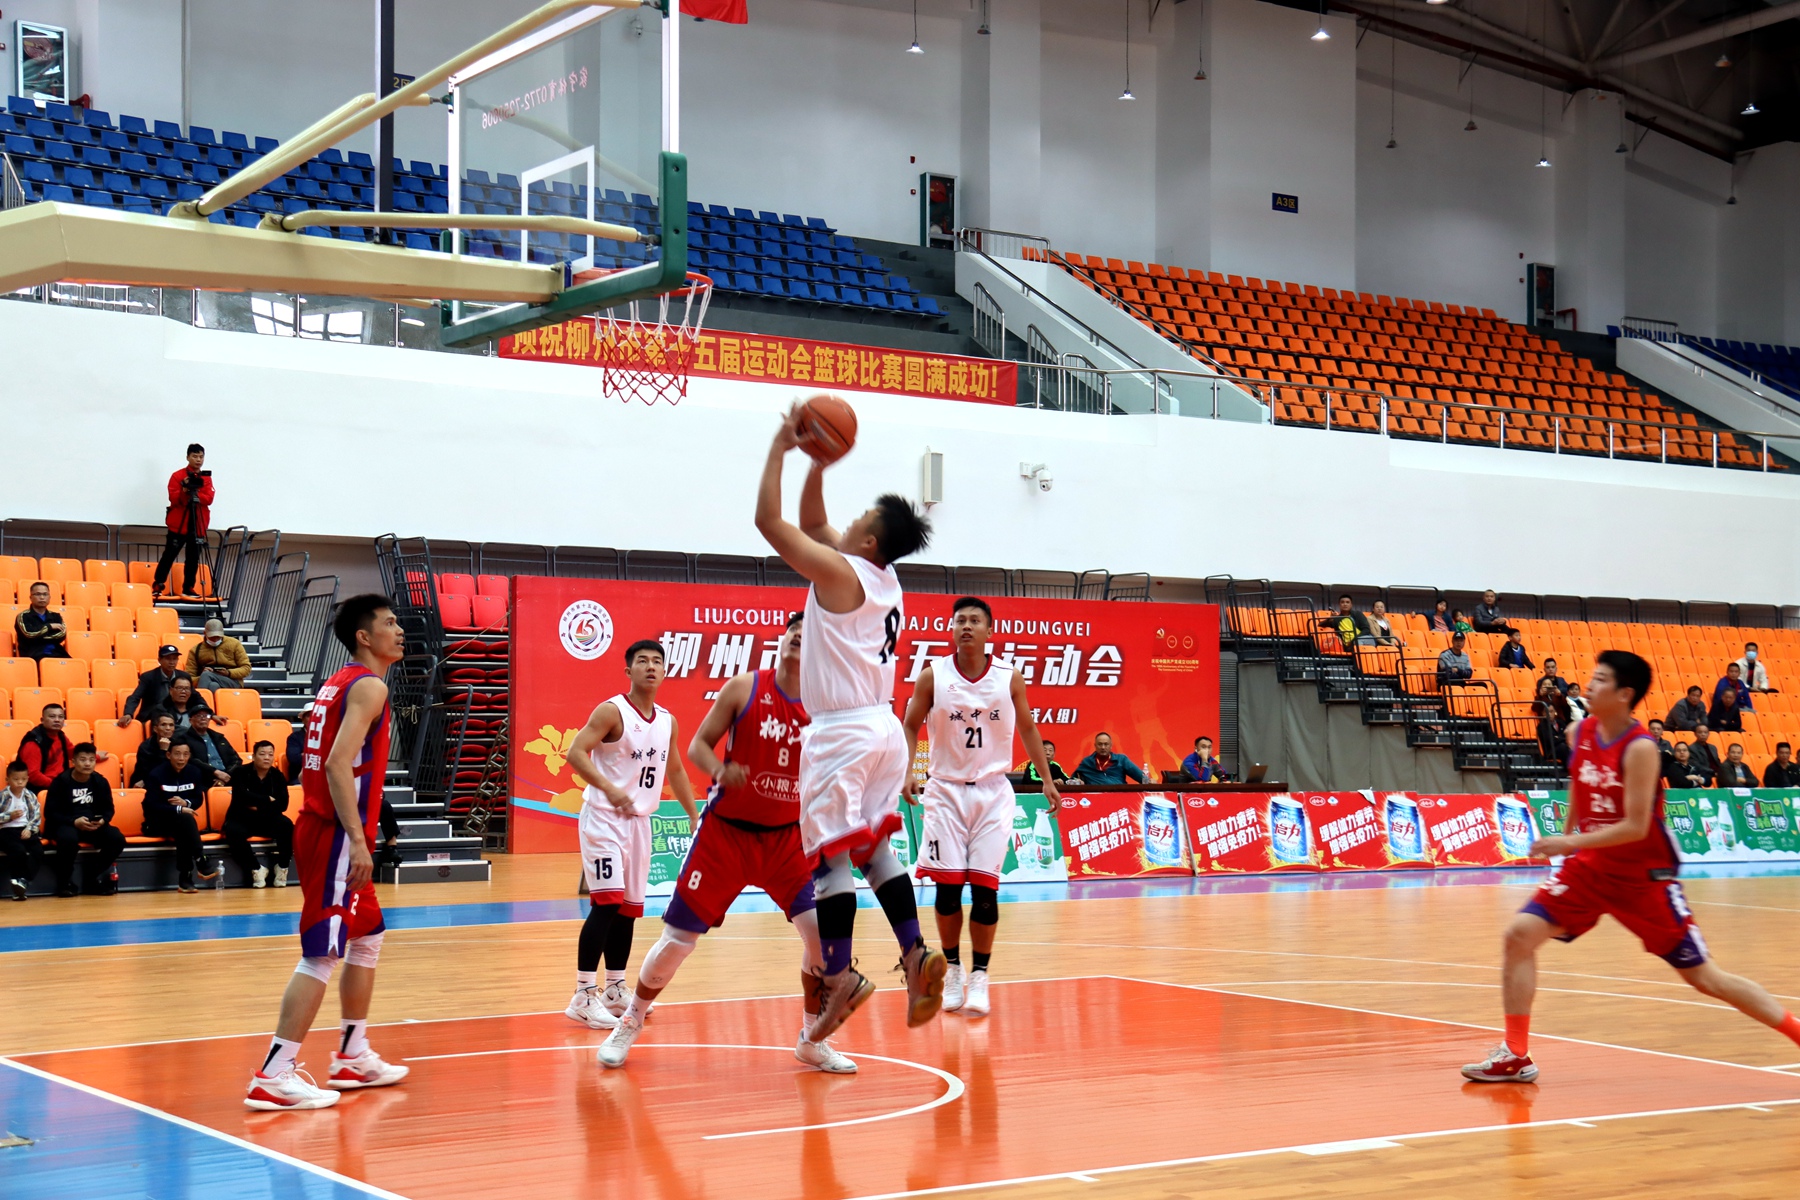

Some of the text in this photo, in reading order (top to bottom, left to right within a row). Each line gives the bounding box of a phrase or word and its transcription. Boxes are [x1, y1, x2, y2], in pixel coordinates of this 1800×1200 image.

[393, 76, 411, 89] 2区
[1276, 196, 1296, 209] A3区
[694, 607, 784, 626] LIUJCOUH
[994, 619, 1091, 637] INDUNGVEI
[949, 708, 1001, 723] 城中区
[965, 727, 982, 749] 21
[777, 747, 790, 767] 8
[639, 766, 656, 789] 15
[1068, 808, 1131, 847] 缓解体力疲劳
[1197, 807, 1258, 845] 缓解体力疲劳
[1319, 806, 1375, 842] 缓解体力疲劳
[1078, 825, 1135, 861] 增强免疫力!
[1207, 823, 1263, 859] 增强免疫力!
[1329, 822, 1379, 855] 增强免疫力!
[928, 840, 941, 861] 21
[594, 857, 613, 880] 15
[688, 870, 702, 890] 8
